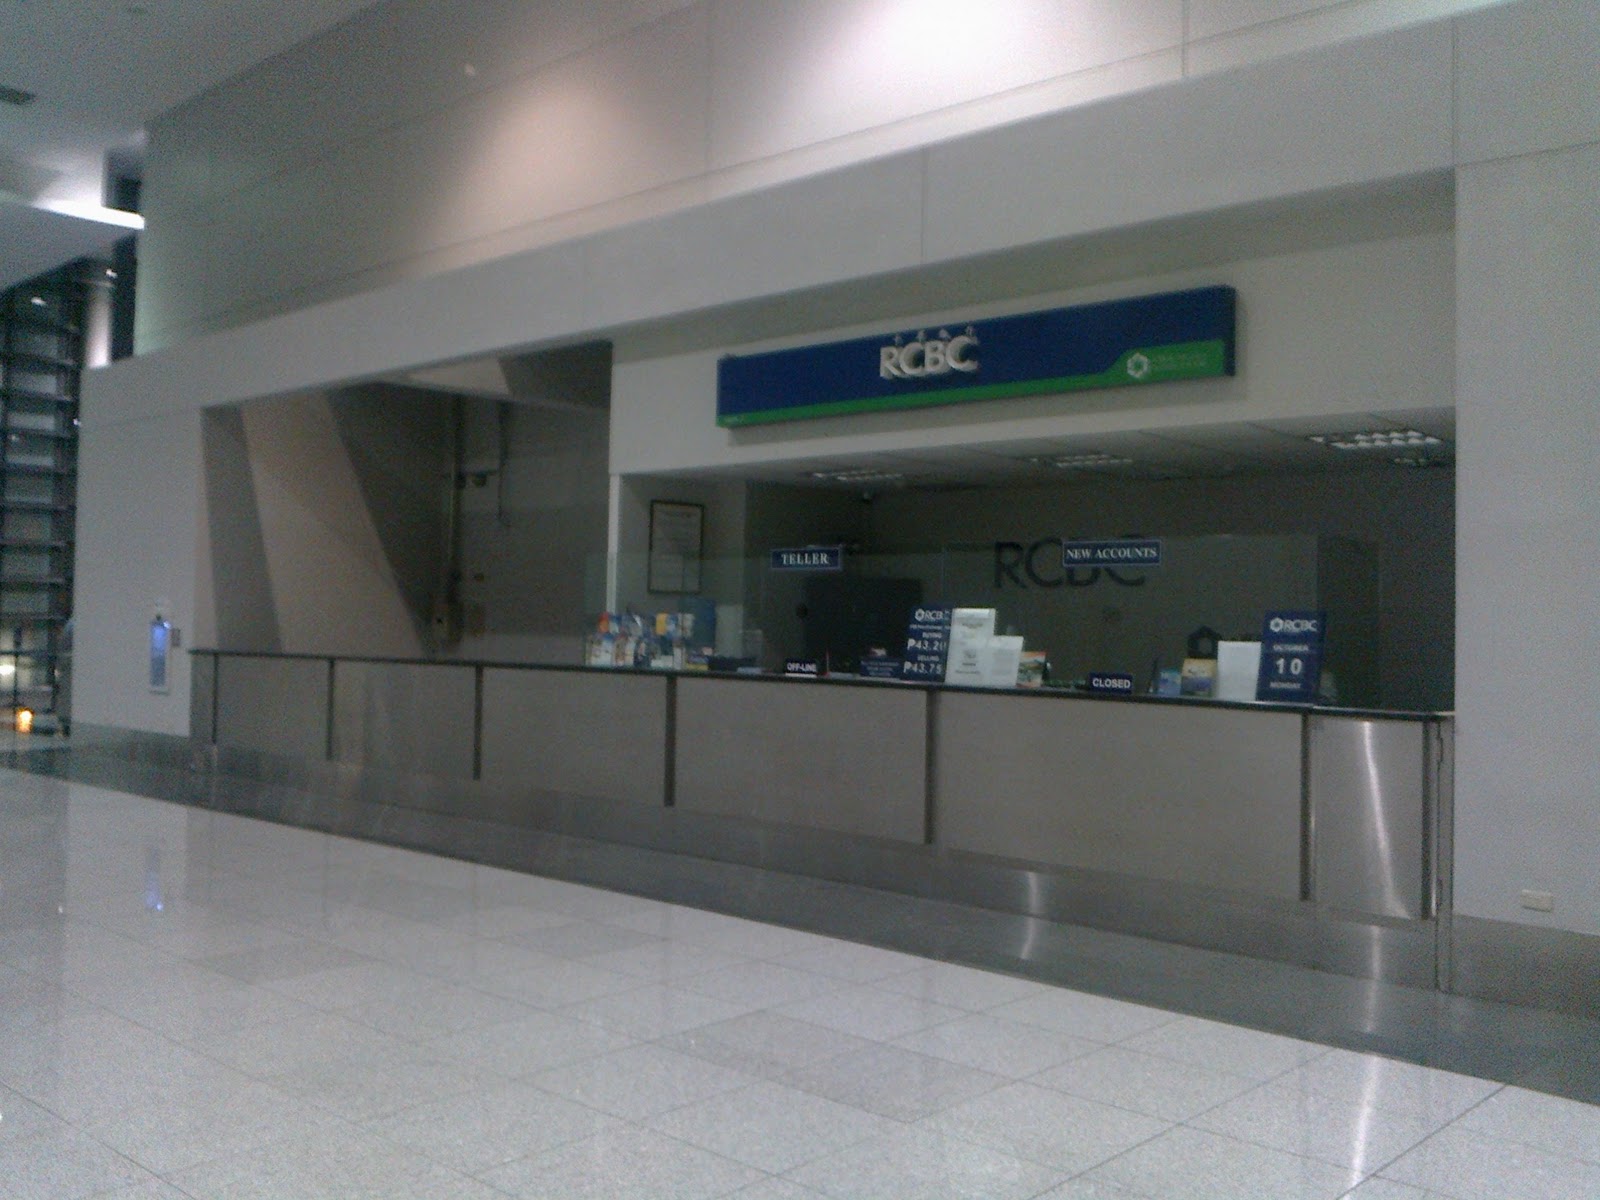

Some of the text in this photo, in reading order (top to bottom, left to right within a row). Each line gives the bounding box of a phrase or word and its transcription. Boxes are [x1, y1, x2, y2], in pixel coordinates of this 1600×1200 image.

[880, 335, 978, 379] RCBC
[1066, 547, 1157, 559] NEW ACCOUNTS
[781, 553, 830, 567] TELLER
[1283, 619, 1318, 632] RCBC
[1092, 677, 1131, 689] CLOSED
